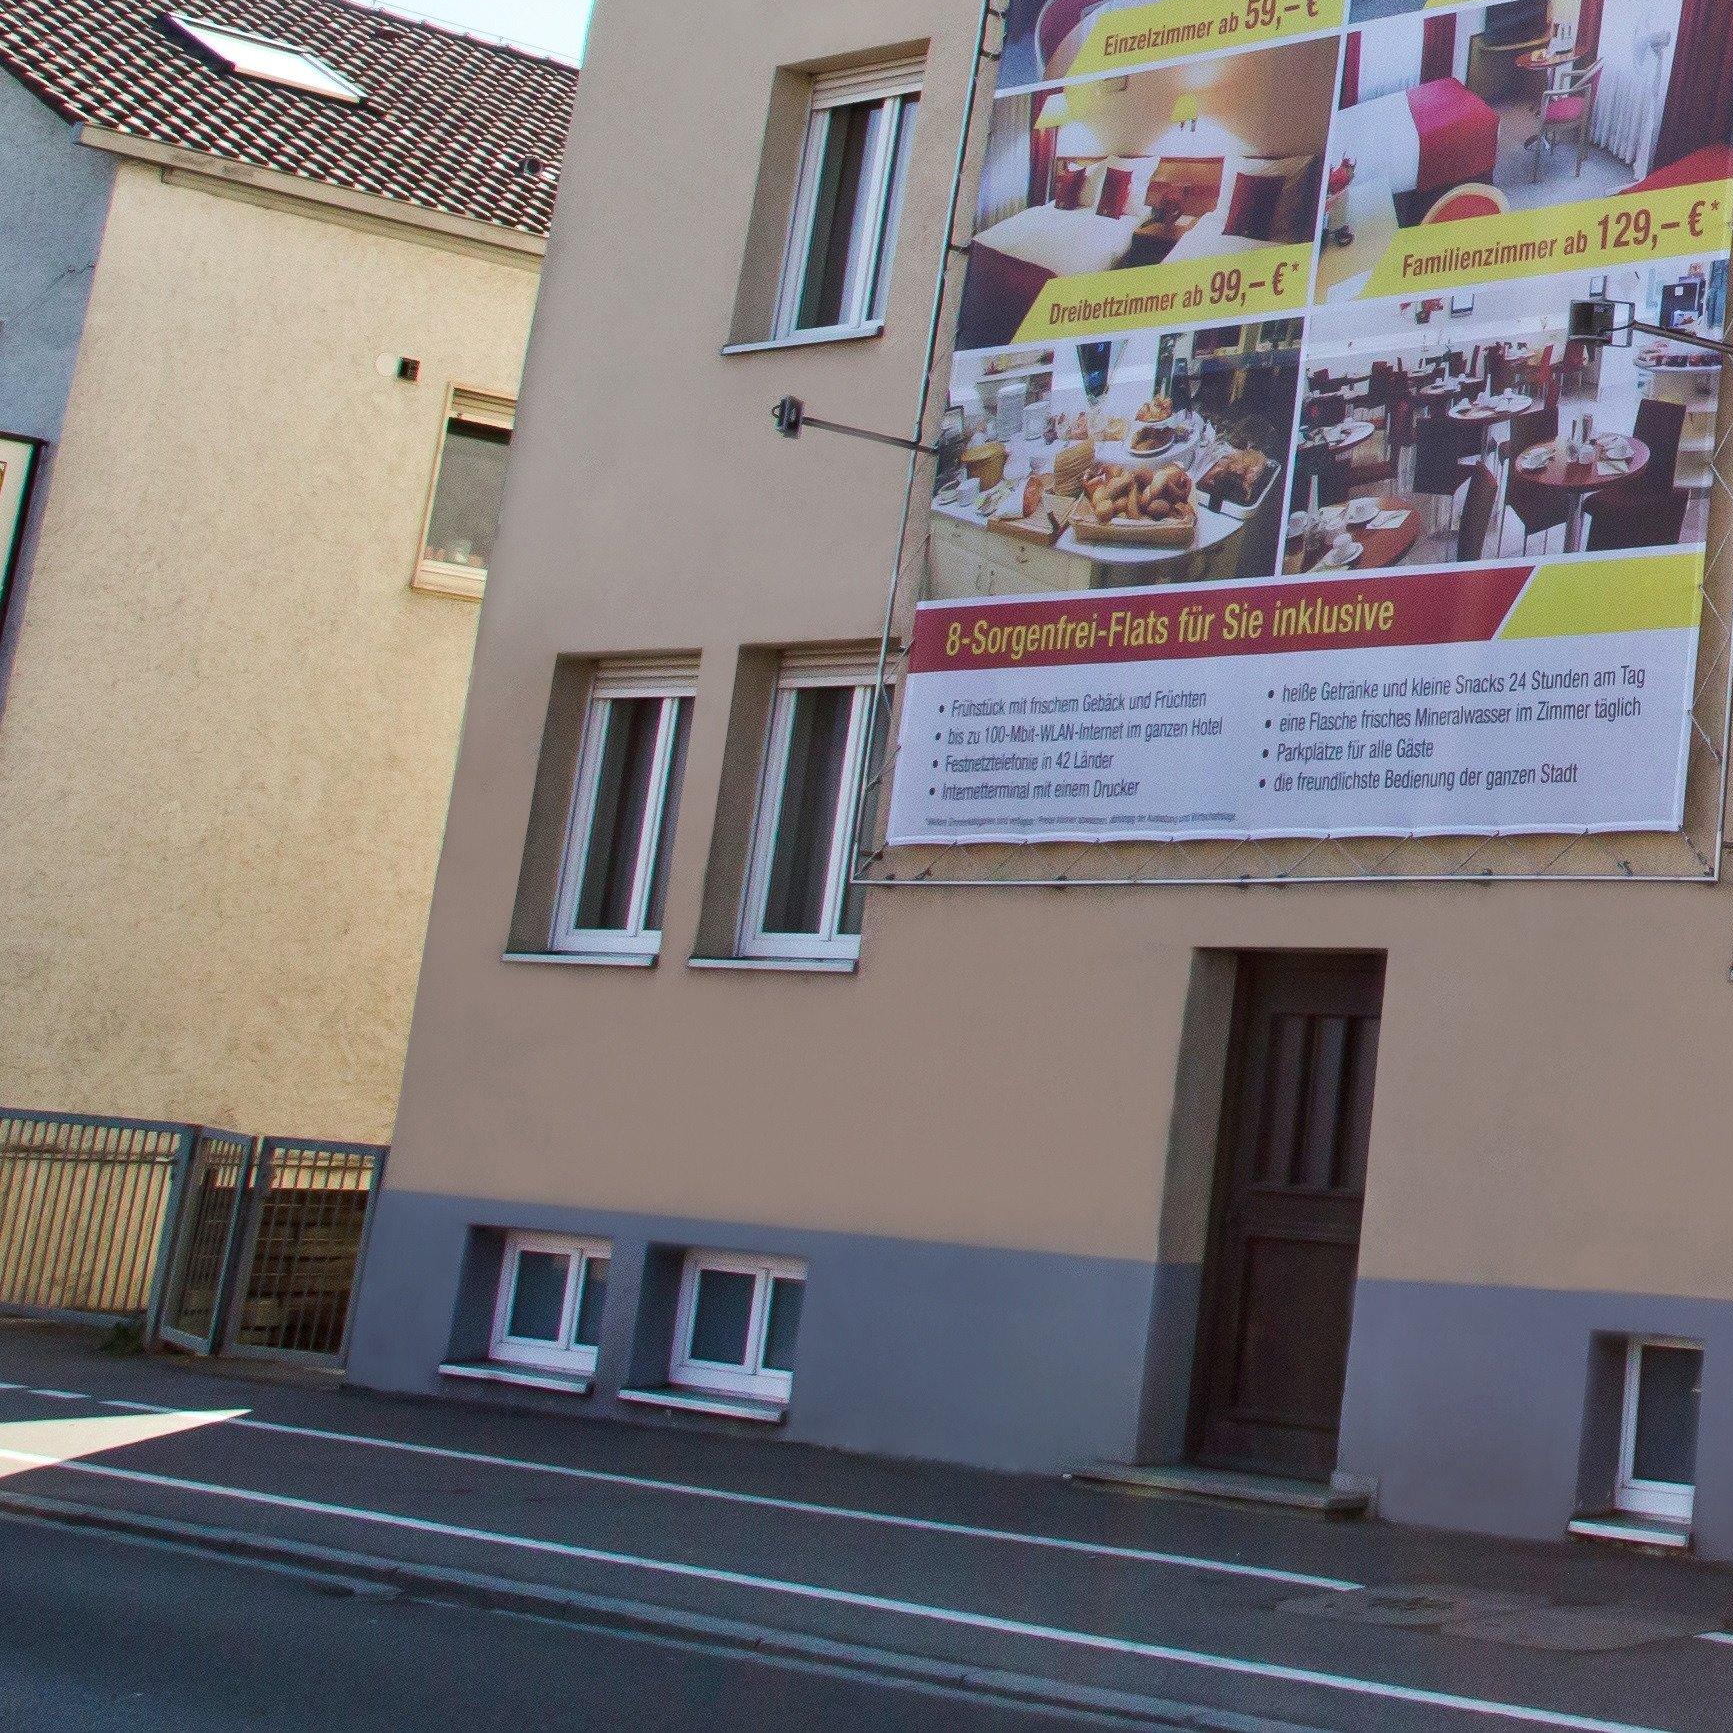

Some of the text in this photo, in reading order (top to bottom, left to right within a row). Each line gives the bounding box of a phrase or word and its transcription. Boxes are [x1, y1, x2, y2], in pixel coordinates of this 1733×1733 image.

[1103, 19, 1213, 57] Einzelzimmer
[1219, 12, 1240, 35] ab
[1402, 235, 1557, 278] Familienzimmer
[1564, 230, 1588, 255] ab
[1050, 292, 1176, 325] Dreibettzimmer
[1183, 285, 1203, 308] ab
[946, 594, 1395, 660] 8-Sorgenfrei-Flats für Sie inklusive
[1282, 665, 1646, 702] heiße Getränke und kleine Snacks 24 Stunden am Tag
[951, 690, 1207, 717] Frühstück mit frischem Gebäck und Früchten
[1279, 697, 1641, 732] eine Flasche frisches Mineralwasser im Zimmer täglich
[948, 727, 964, 745] bis
[967, 730, 981, 745] zu
[1127, 721, 1142, 738] im
[1145, 722, 1187, 742] ganzen
[1191, 717, 1223, 735] Hotel
[945, 750, 1114, 772] Festnetztelefonie in 42 Länder
[1276, 738, 1434, 764] Parkplätze für alle Gäste
[942, 779, 1140, 800] Internetterminal mit einem Drucker
[1273, 764, 1578, 792] die freundlichste Bedienung der ganzen Stadt
